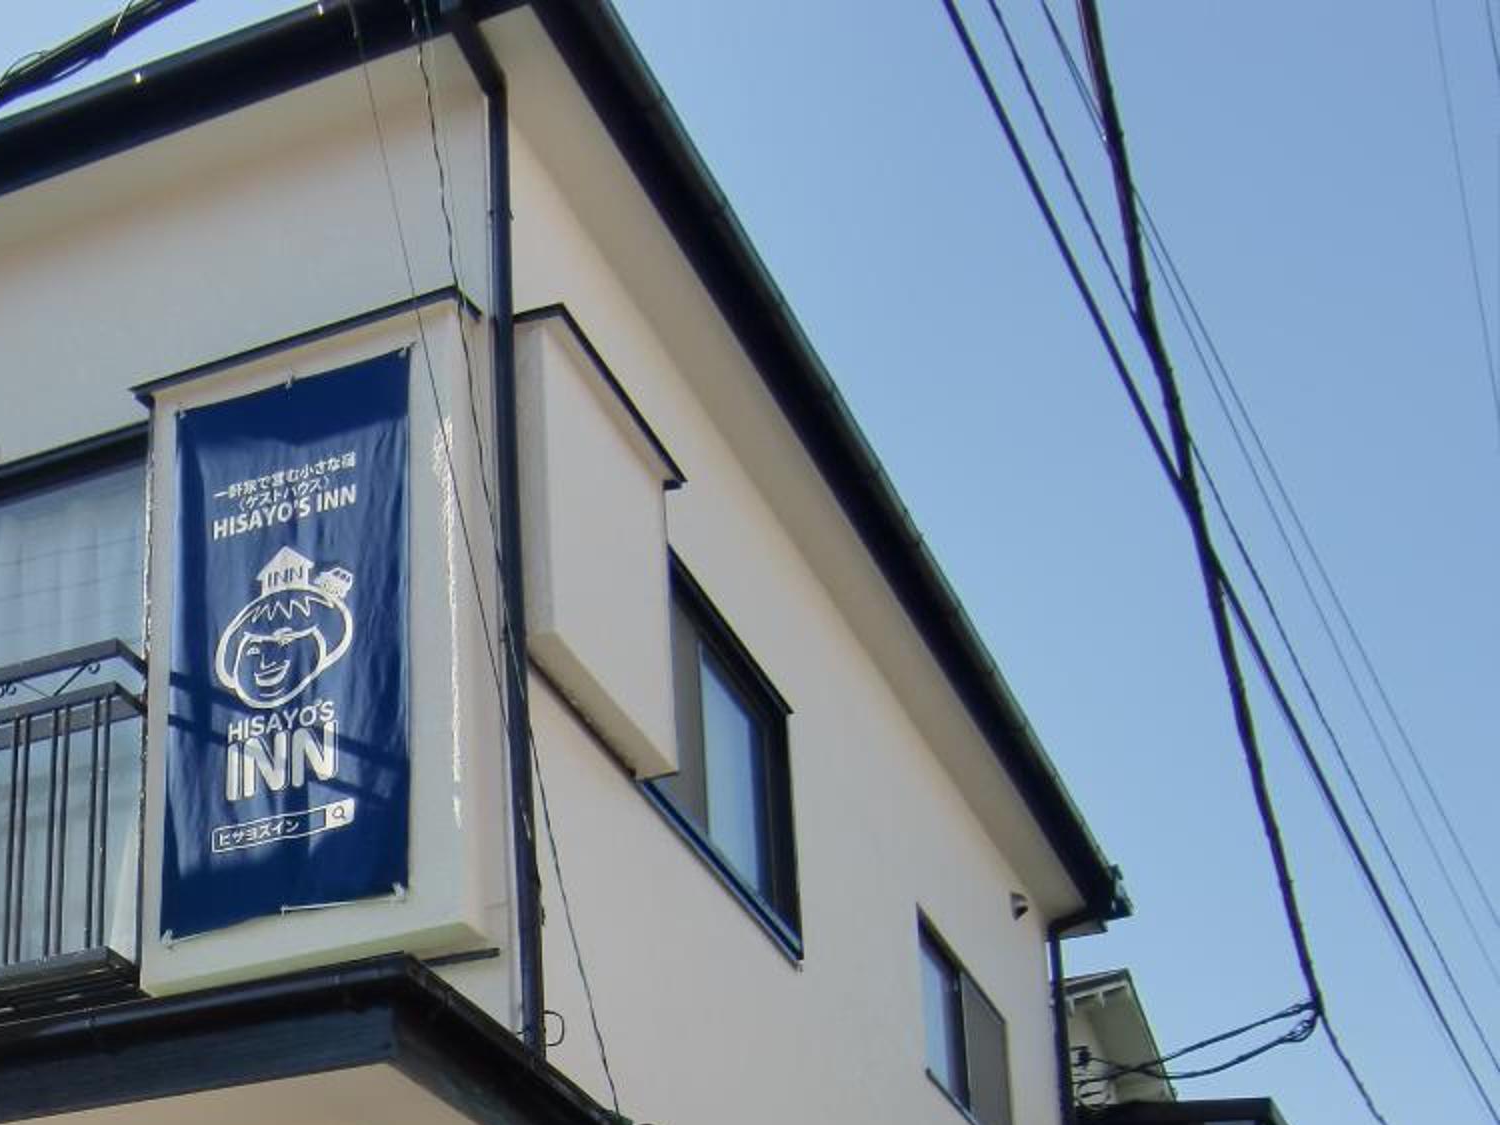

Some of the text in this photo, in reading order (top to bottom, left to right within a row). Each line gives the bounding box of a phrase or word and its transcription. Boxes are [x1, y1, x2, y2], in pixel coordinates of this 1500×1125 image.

[213, 484, 356, 540] HISAYO'S INN
[267, 567, 304, 588] INN
[226, 718, 339, 801] INN
